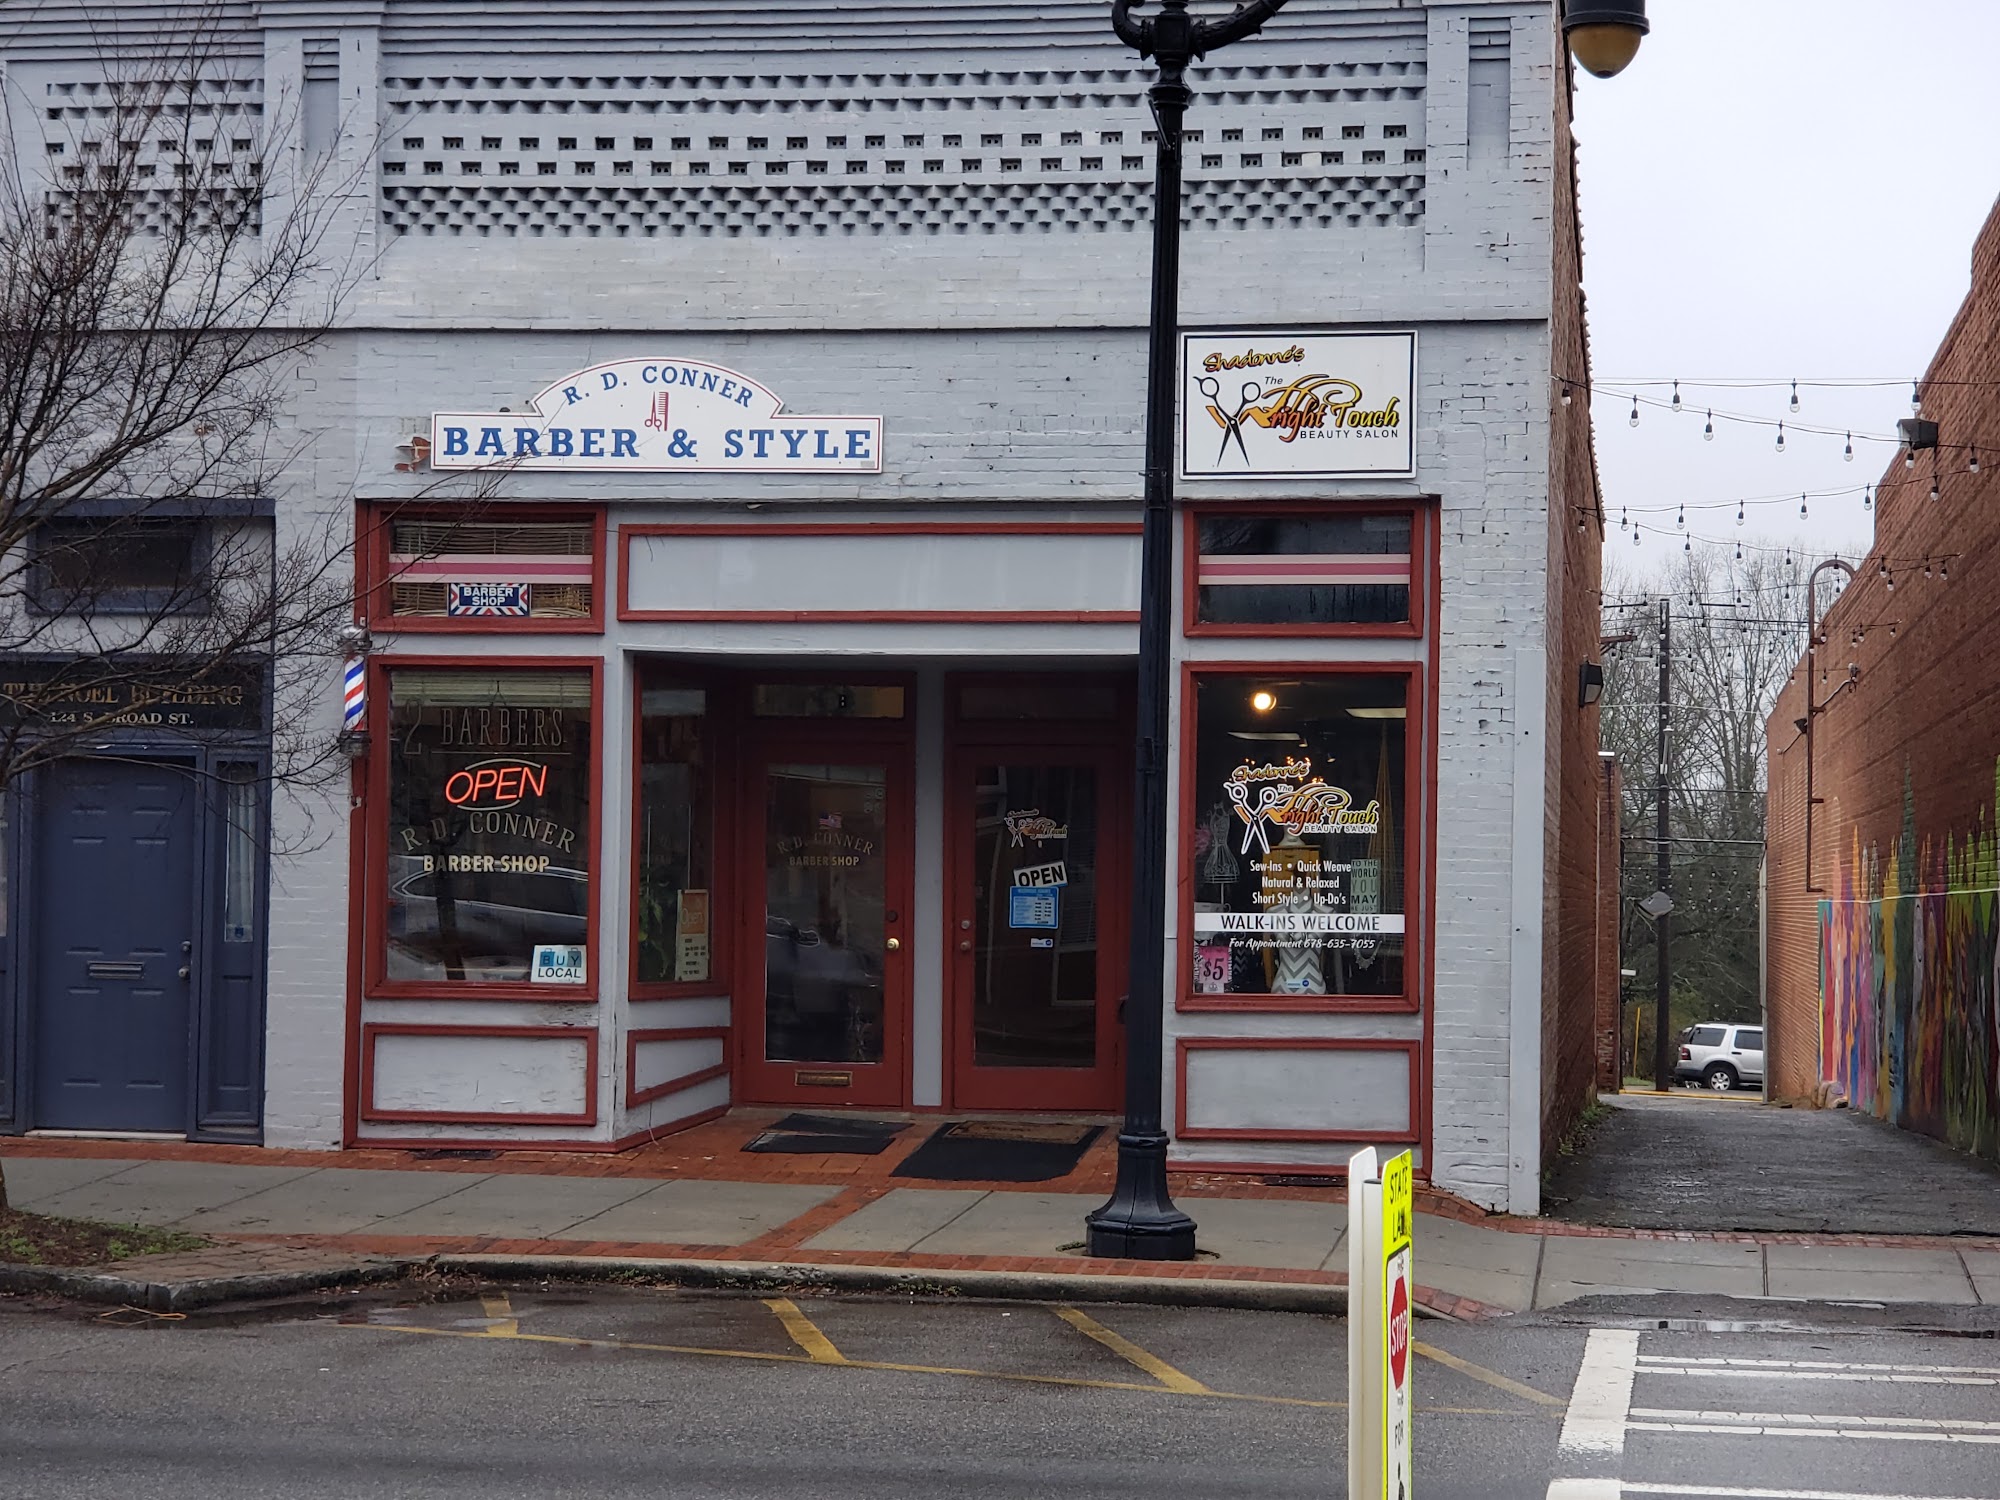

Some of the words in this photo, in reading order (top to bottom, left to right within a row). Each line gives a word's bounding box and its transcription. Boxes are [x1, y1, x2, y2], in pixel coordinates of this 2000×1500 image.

[1203, 345, 1305, 372] Shadonne's
[562, 386, 590, 406] R.
[600, 371, 628, 392] D.
[642, 365, 754, 408] CONNER
[1264, 376, 1283, 385] The
[1322, 378, 1400, 429] Touch
[1300, 429, 1350, 440] BEAUTY
[1356, 429, 1399, 439] SALON
[443, 426, 639, 458] BARBER
[667, 428, 698, 459] &
[724, 429, 871, 459] STYLE
[463, 587, 514, 597] BARBER
[472, 596, 506, 606] SHOP
[105, 712, 162, 723] ROAD
[168, 712, 195, 724] ST.
[403, 699, 423, 755] 2
[440, 708, 564, 746] BARBERS
[445, 764, 547, 804] OPEN
[1277, 784, 1293, 793] The
[1324, 784, 1379, 824] Touch
[470, 811, 577, 854] CONNER
[1303, 825, 1343, 834] BEAUTY
[1344, 825, 1378, 834] SALON
[814, 832, 874, 856] CONNER
[423, 855, 495, 873] BARBER
[501, 855, 550, 873] SHOP
[789, 856, 829, 867] BARBER
[831, 856, 860, 866] SHOP
[1250, 860, 1283, 872] Sew-Ins
[1297, 860, 1322, 873] Quick
[1323, 860, 1351, 872] Weave
[1018, 865, 1064, 887] OPEN
[1351, 868, 1378, 878] WORLD
[1262, 876, 1295, 888] Natural
[1296, 877, 1304, 888] &
[1305, 876, 1340, 889] Relaxed
[1351, 879, 1377, 894] YOU
[1252, 893, 1275, 905] Short
[1276, 893, 1299, 906] Style
[1313, 893, 1346, 907] Up-Do's
[1351, 894, 1377, 904] MAY
[1221, 915, 1296, 931] WALK-INS
[1302, 915, 1380, 931] WELCOME
[1229, 938, 1244, 948] For
[1245, 938, 1302, 950] Appointment
[542, 955, 581, 966] BUY
[537, 967, 581, 979] LOCAL
[1203, 957, 1224, 981] $5
[1390, 1166, 1408, 1205] STATE
[1391, 1309, 1408, 1357] STOP
